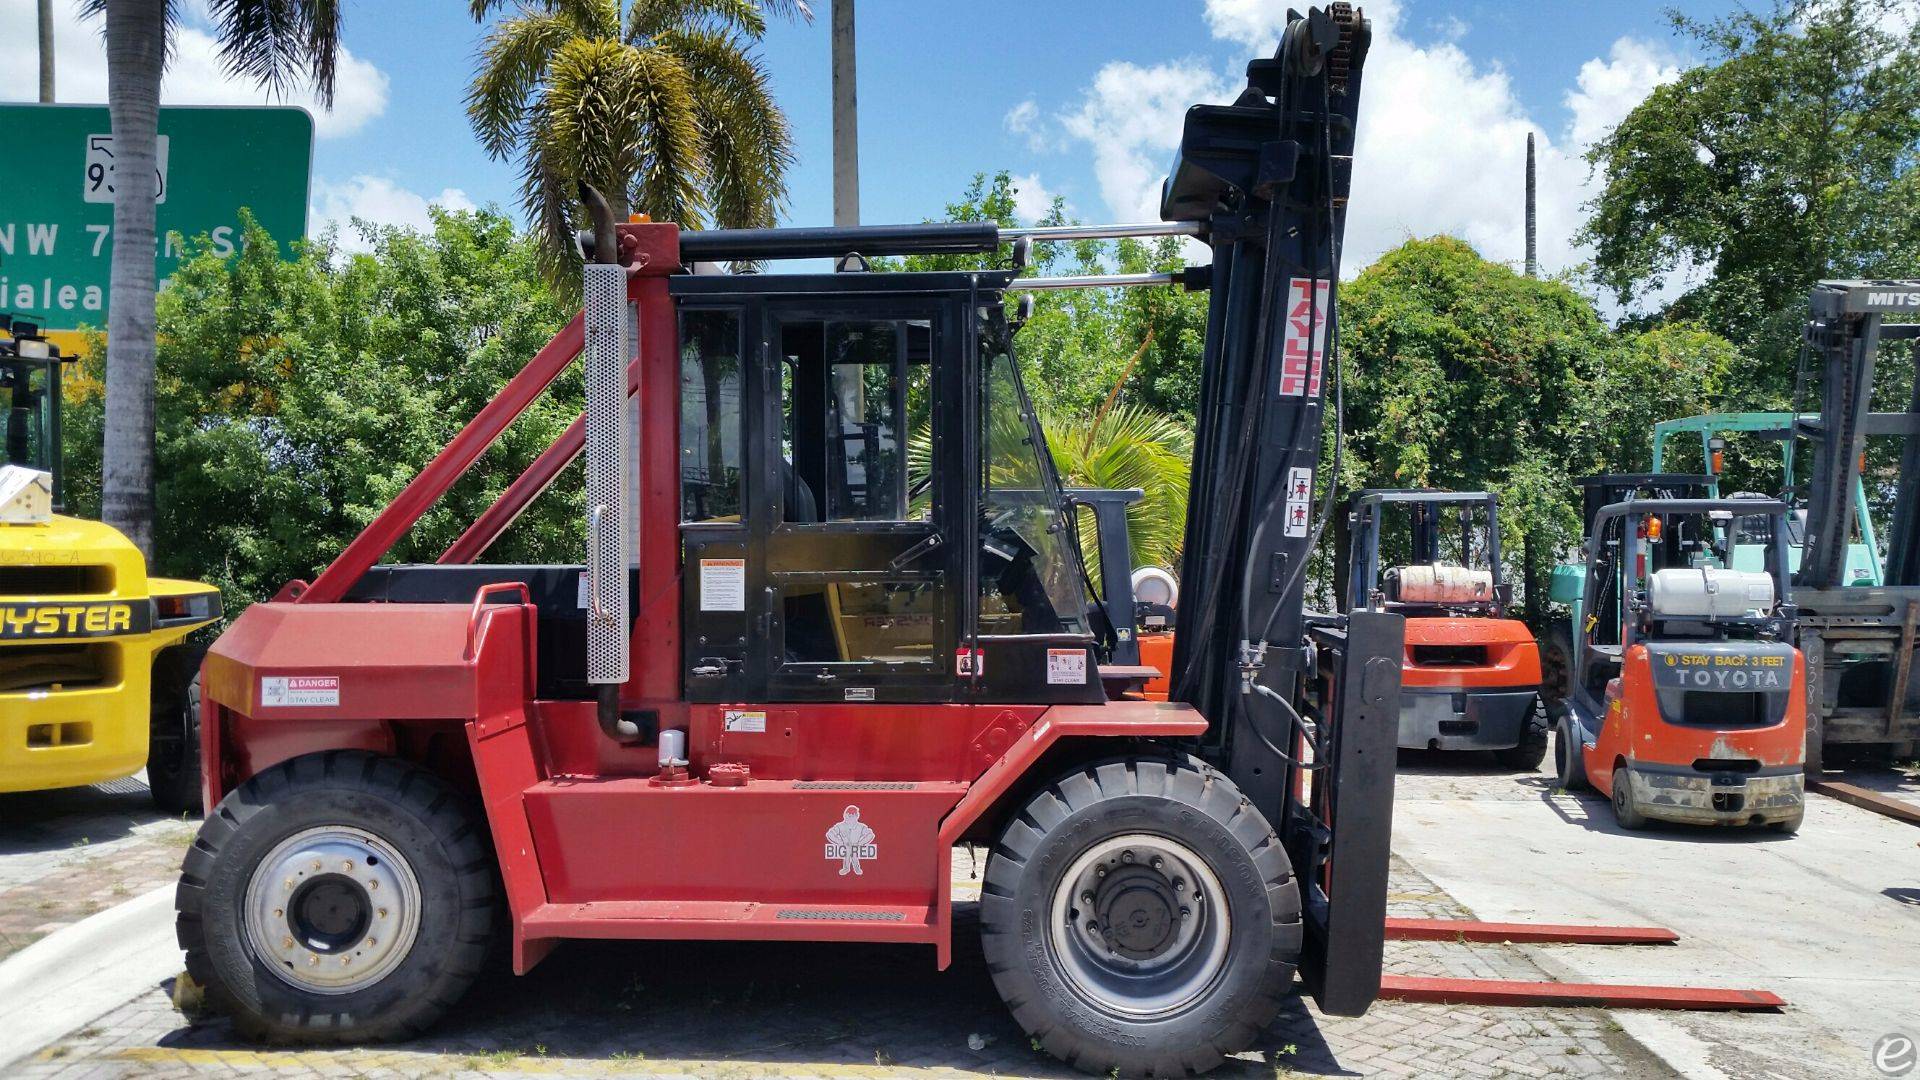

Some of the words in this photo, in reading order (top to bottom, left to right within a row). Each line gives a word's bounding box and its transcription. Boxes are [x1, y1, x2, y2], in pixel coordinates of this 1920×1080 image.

[0, 223, 59, 256] NW
[0, 276, 103, 311] ialea
[1867, 292, 1920, 306] MITS
[0, 604, 131, 634] YSTER
[1681, 655, 1711, 666] STAY
[1715, 655, 1748, 667] BACK
[1752, 656, 1759, 667] 3
[1761, 656, 1785, 667] FEET
[298, 679, 337, 687] DANGER
[1676, 669, 1779, 688] TOYOTA
[826, 845, 847, 858] BIG
[851, 845, 876, 858] RED
